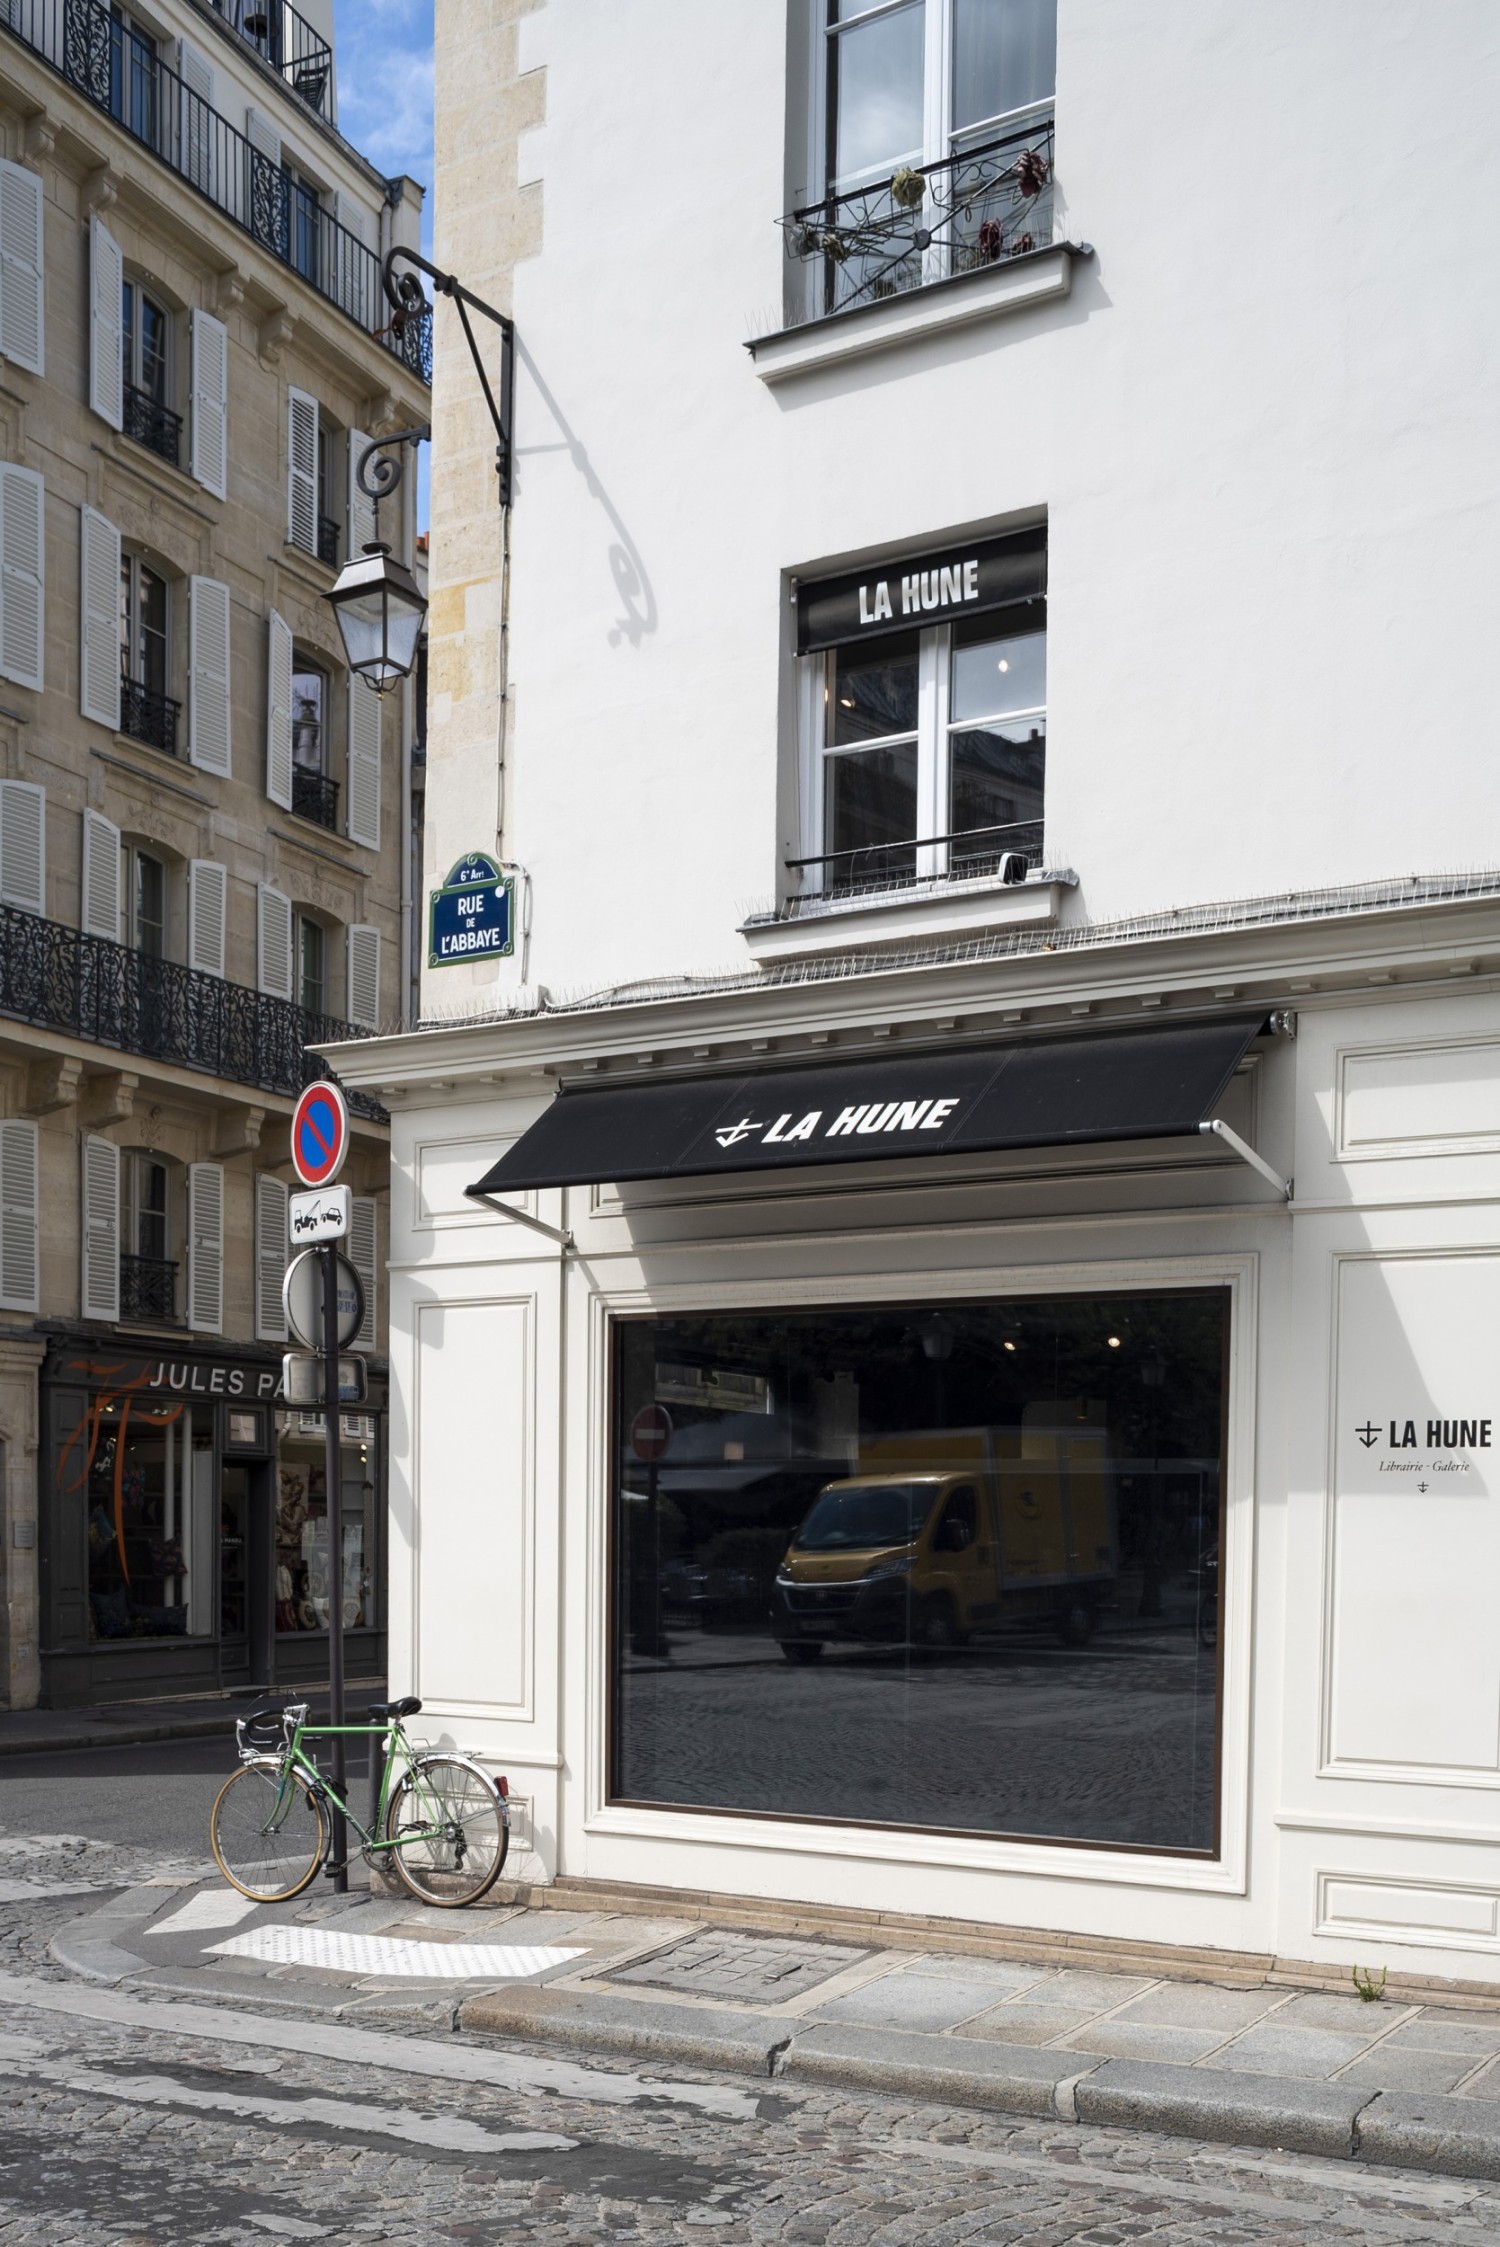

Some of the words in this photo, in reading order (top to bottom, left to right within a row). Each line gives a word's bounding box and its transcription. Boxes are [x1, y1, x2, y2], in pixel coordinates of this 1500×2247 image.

[859, 581, 893, 625] LA
[901, 559, 979, 614] HUNE
[457, 895, 484, 916] RUE
[466, 917, 476, 928] DE
[441, 928, 500, 954] L'ABBAYE
[760, 1111, 823, 1144] LA
[824, 1098, 961, 1138] HUNE
[149, 1362, 245, 1395] JULES
[1389, 1420, 1418, 1448] LA
[1426, 1419, 1492, 1448] HUNE
[1379, 1461, 1423, 1471] Librairie
[1432, 1460, 1470, 1471] Galerie
